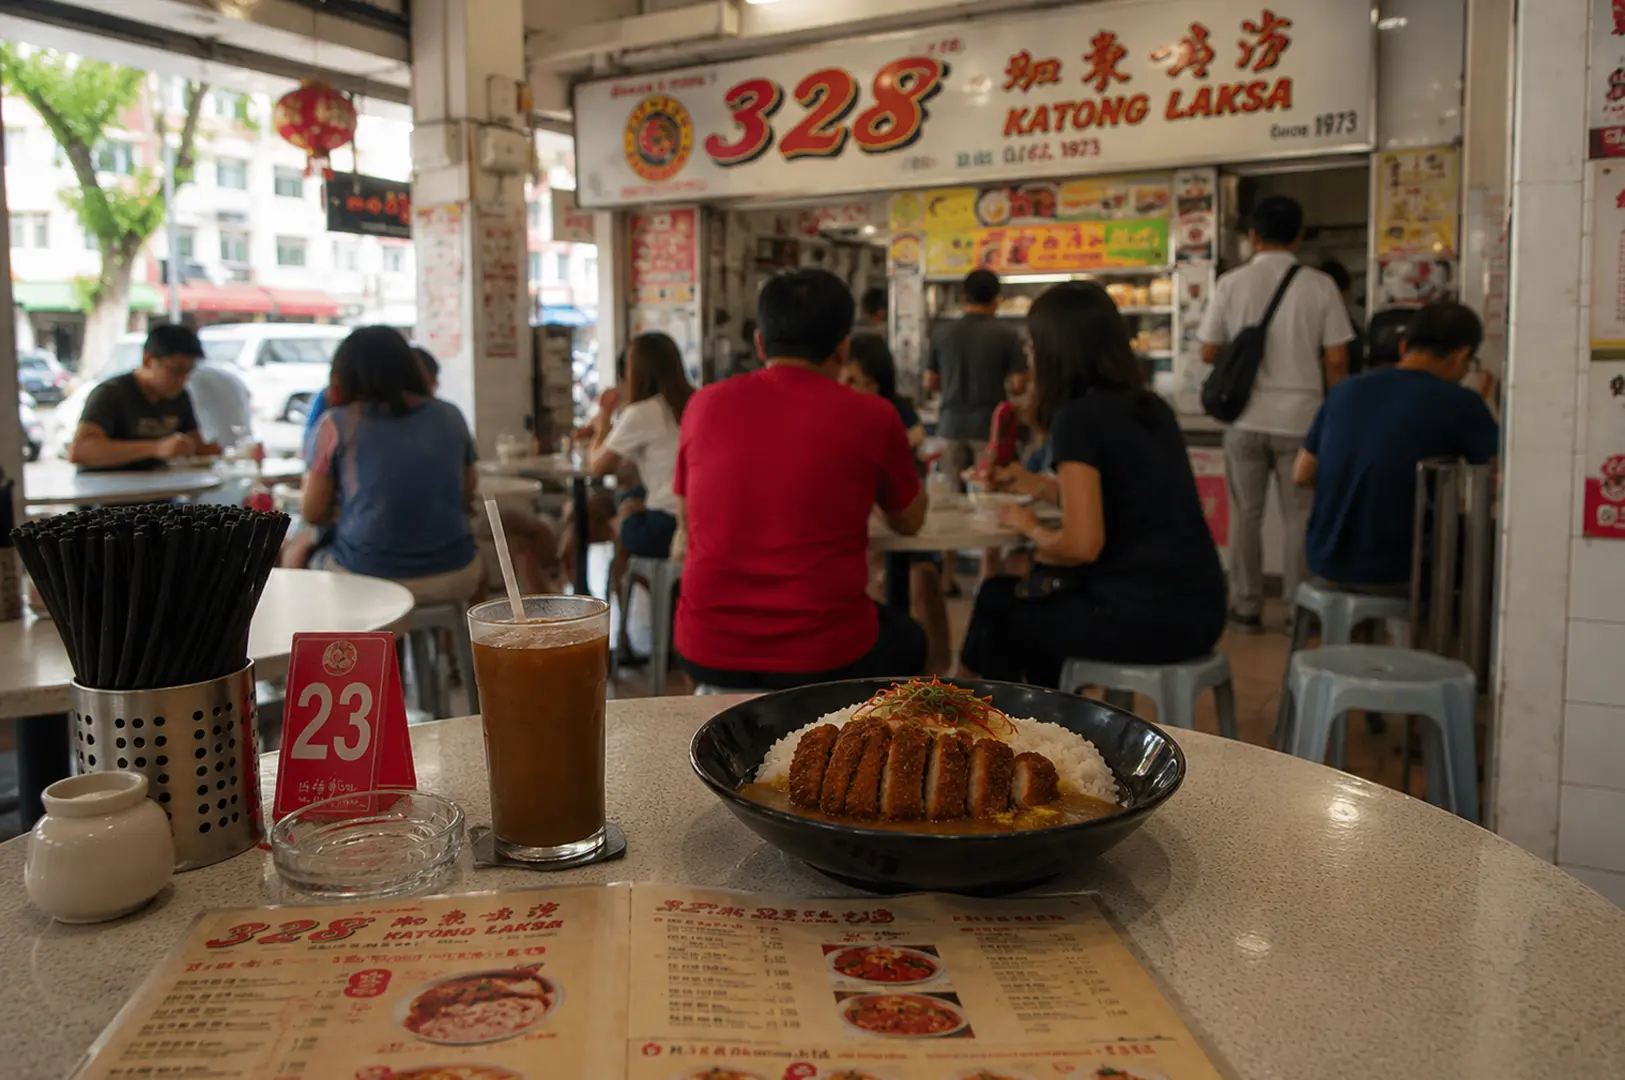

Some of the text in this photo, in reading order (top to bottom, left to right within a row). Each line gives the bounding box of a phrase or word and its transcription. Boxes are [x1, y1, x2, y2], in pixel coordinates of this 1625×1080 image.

[704, 57, 949, 166] 328
[1003, 77, 1292, 136] KATONG LAKSA
[1315, 109, 1357, 136] 1973
[291, 682, 373, 761] 23
[205, 917, 376, 948] 328
